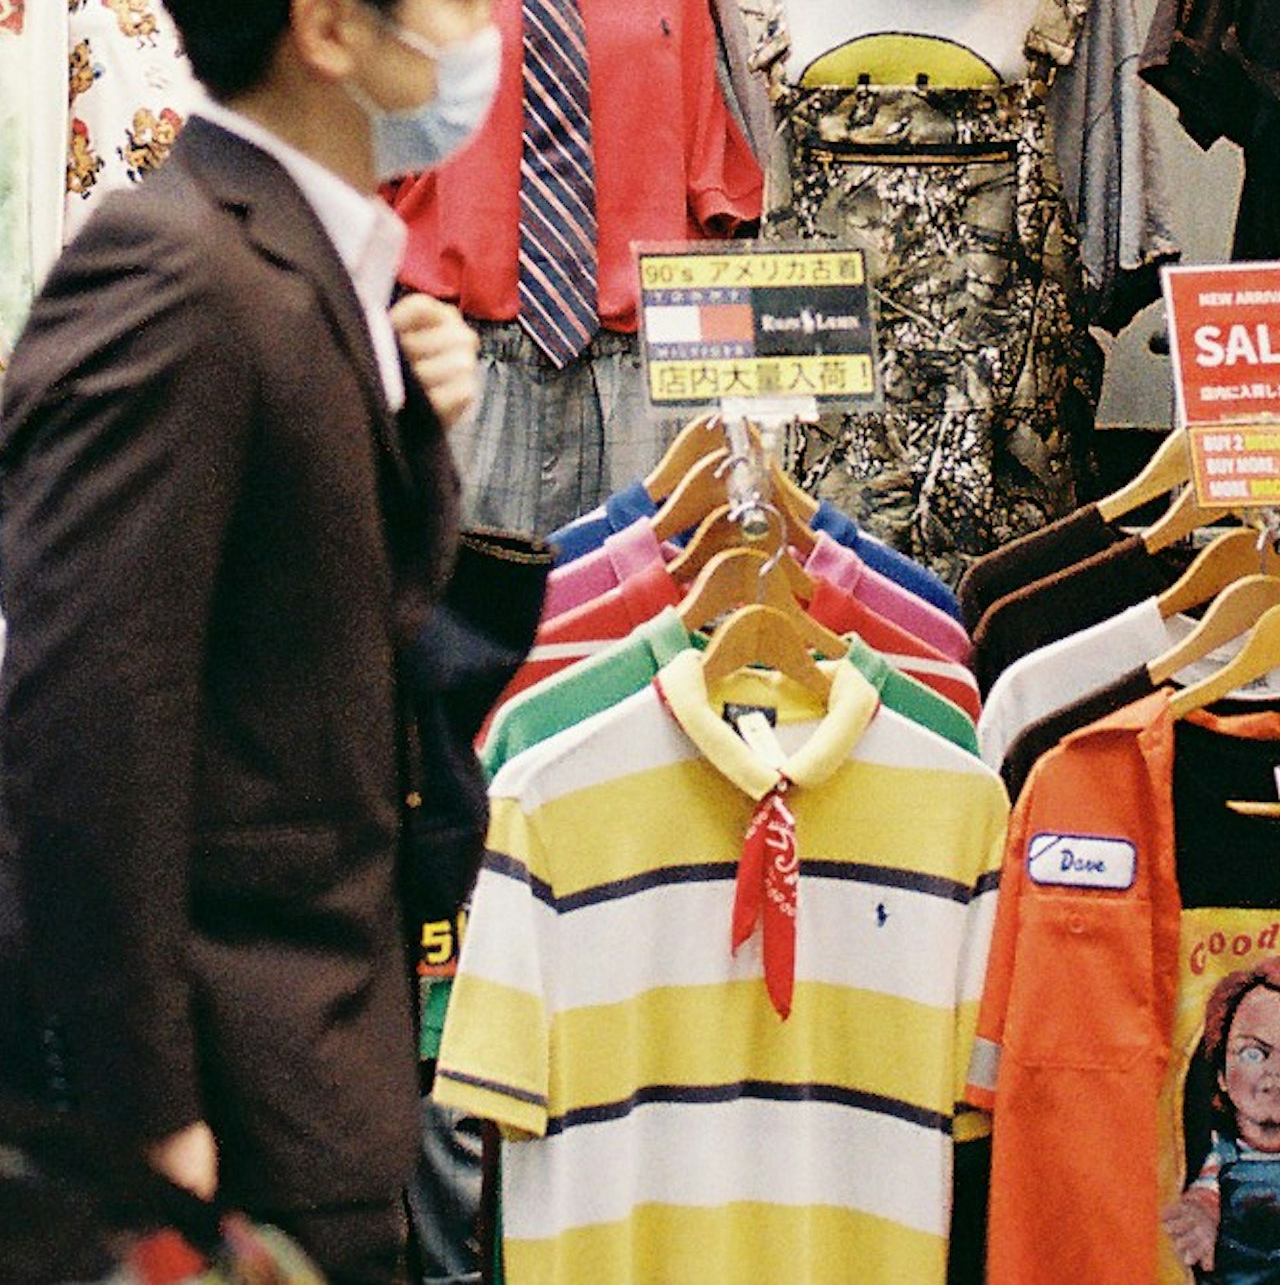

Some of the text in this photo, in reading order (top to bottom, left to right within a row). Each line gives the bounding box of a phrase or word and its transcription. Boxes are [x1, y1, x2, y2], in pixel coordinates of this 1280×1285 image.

[1198, 292, 1234, 307] NEW
[1060, 850, 1108, 875] Dave
[1189, 922, 1279, 976] Good
